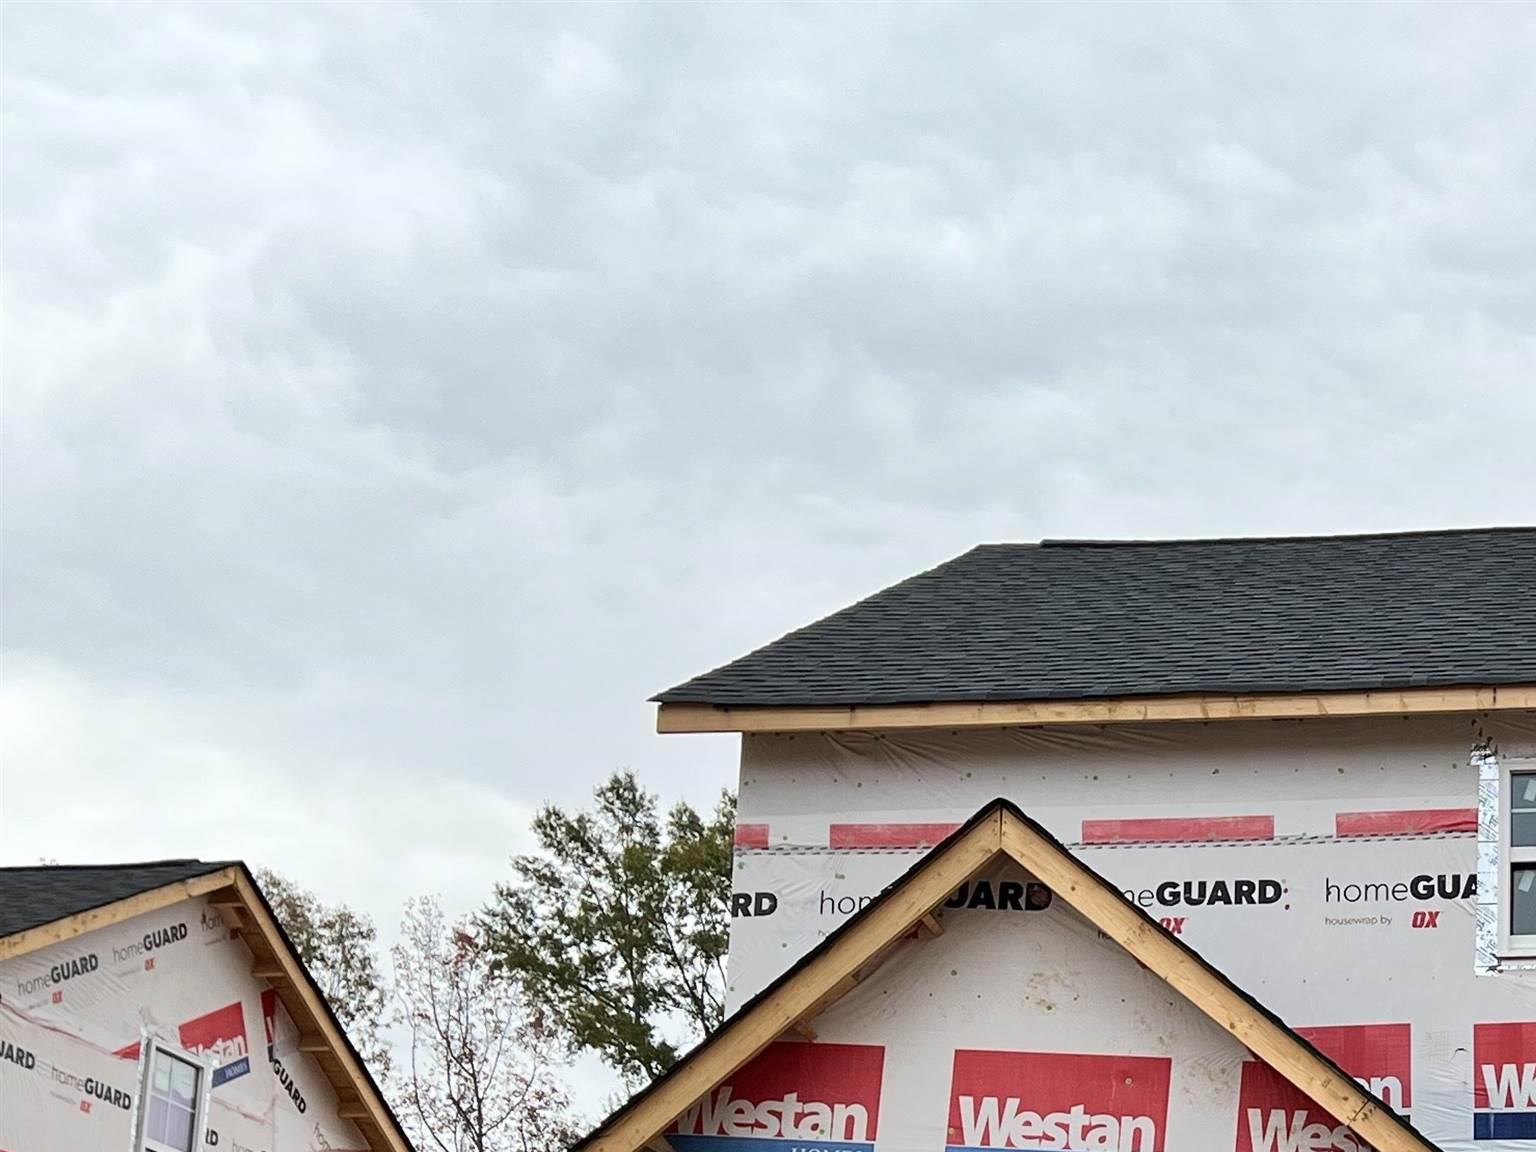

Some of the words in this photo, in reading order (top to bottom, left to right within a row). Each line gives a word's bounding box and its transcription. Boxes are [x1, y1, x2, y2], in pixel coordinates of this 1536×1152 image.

[1122, 880, 1283, 907] eGUARD
[1326, 873, 1478, 904] homeGUA
[1325, 915, 1375, 928] housewrap
[1378, 914, 1392, 928] by
[1412, 910, 1440, 928] OX
[17, 954, 99, 996] homeGUARD
[50, 1065, 131, 1110] homeGUARD
